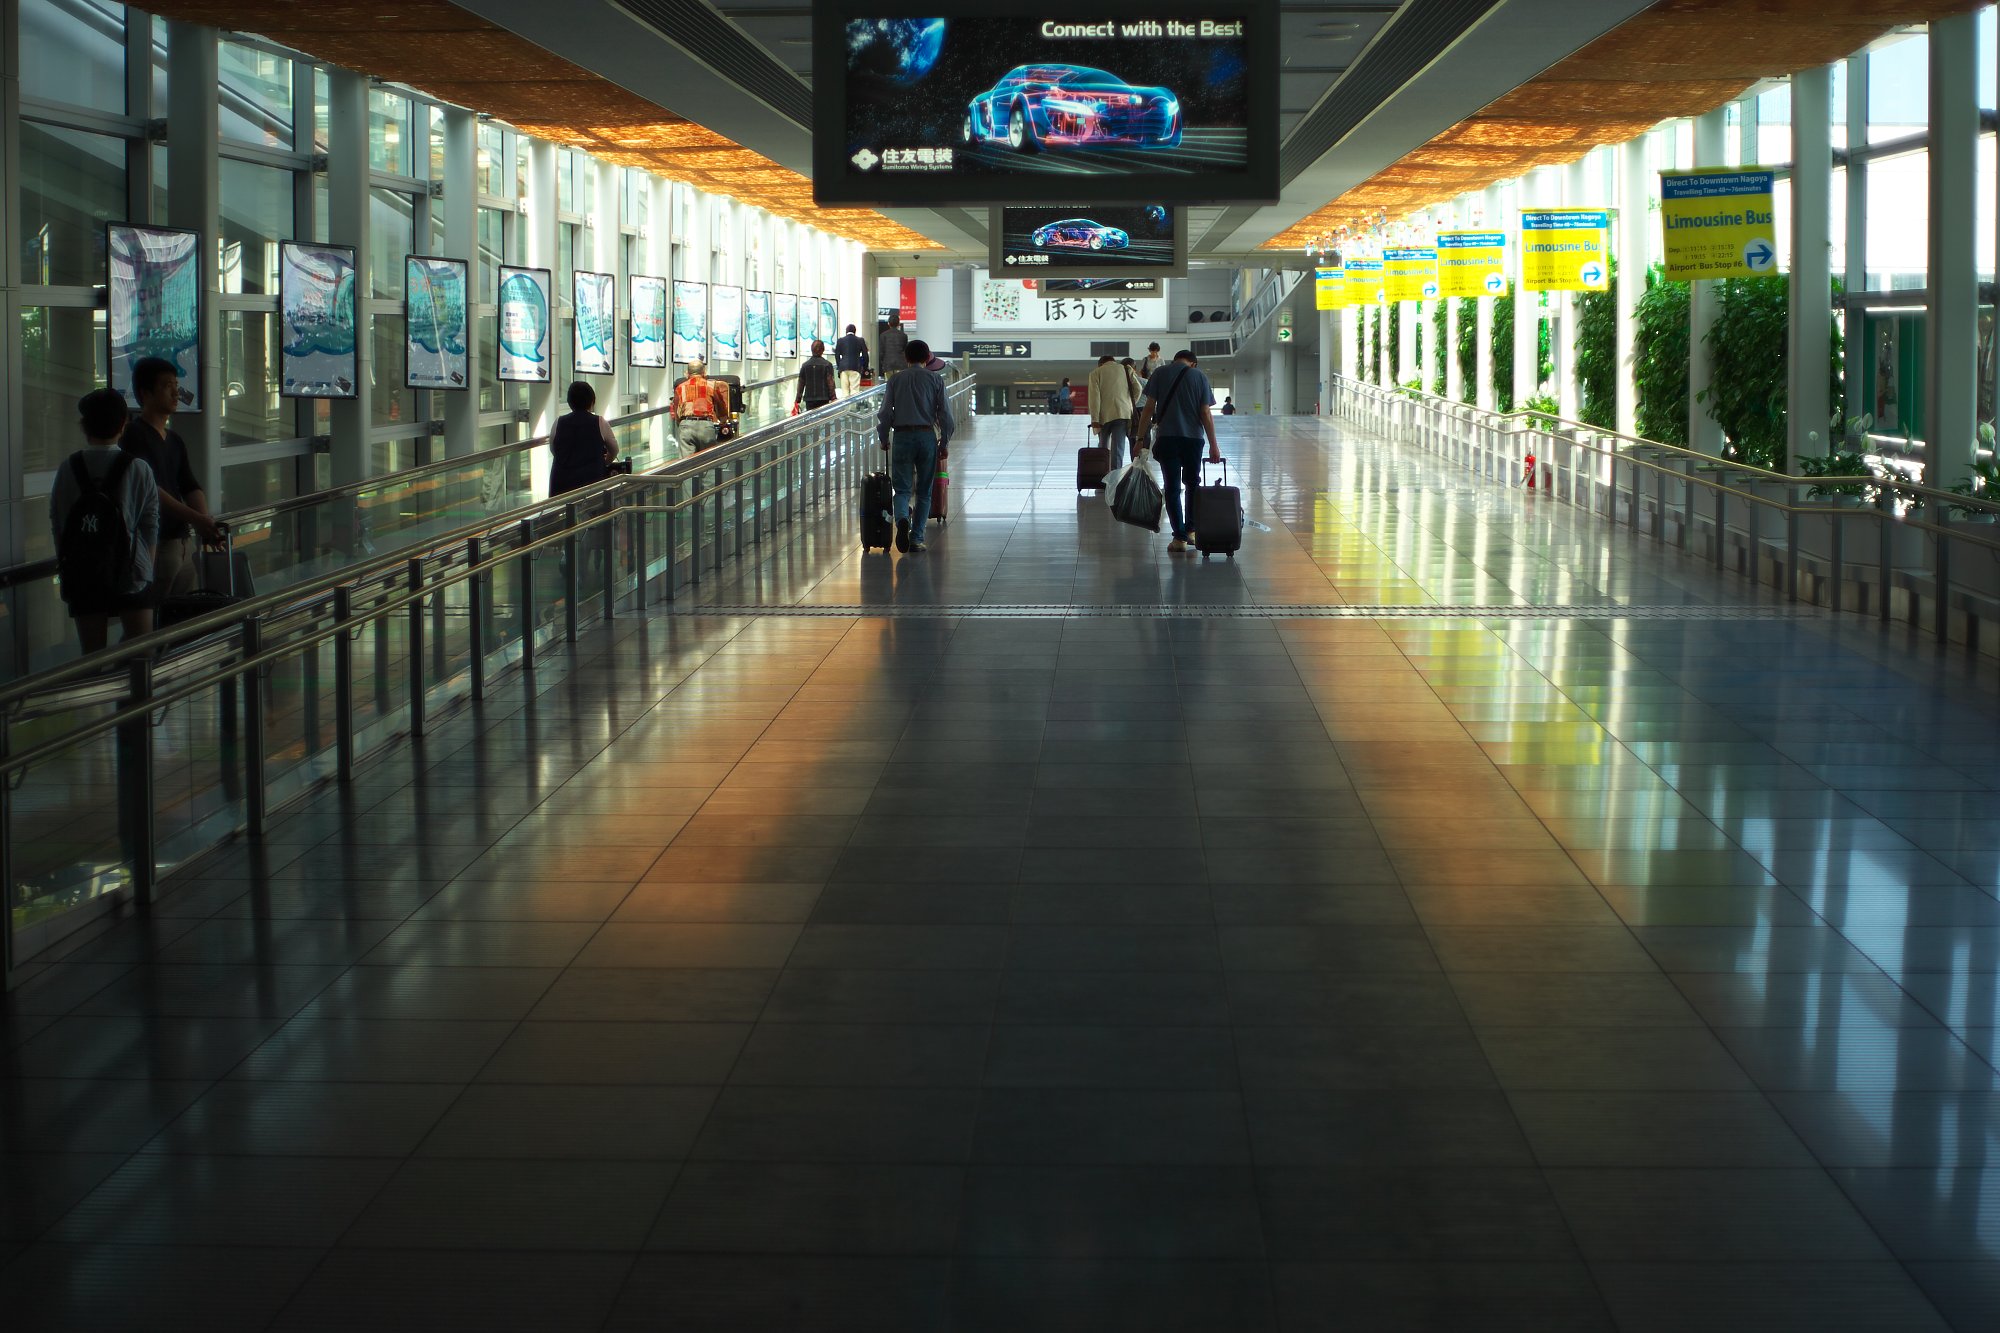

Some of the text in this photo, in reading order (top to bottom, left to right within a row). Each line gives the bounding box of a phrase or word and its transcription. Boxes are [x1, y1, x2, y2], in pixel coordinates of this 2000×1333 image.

[1041, 20, 1243, 37] Connect with the Best
[881, 148, 953, 164] 住友電装
[928, 163, 953, 171] Systems
[1666, 175, 1768, 187] Direct To Downtown Nagoya
[1666, 209, 1772, 230] Limousine Bus
[1525, 241, 1581, 253] Limousine
[1669, 263, 1697, 272] Airport
[1699, 262, 1713, 270] Bus
[1715, 261, 1732, 270] Stop
[1045, 298, 1138, 321] ほうじ茶
[81, 514, 98, 532] NY
